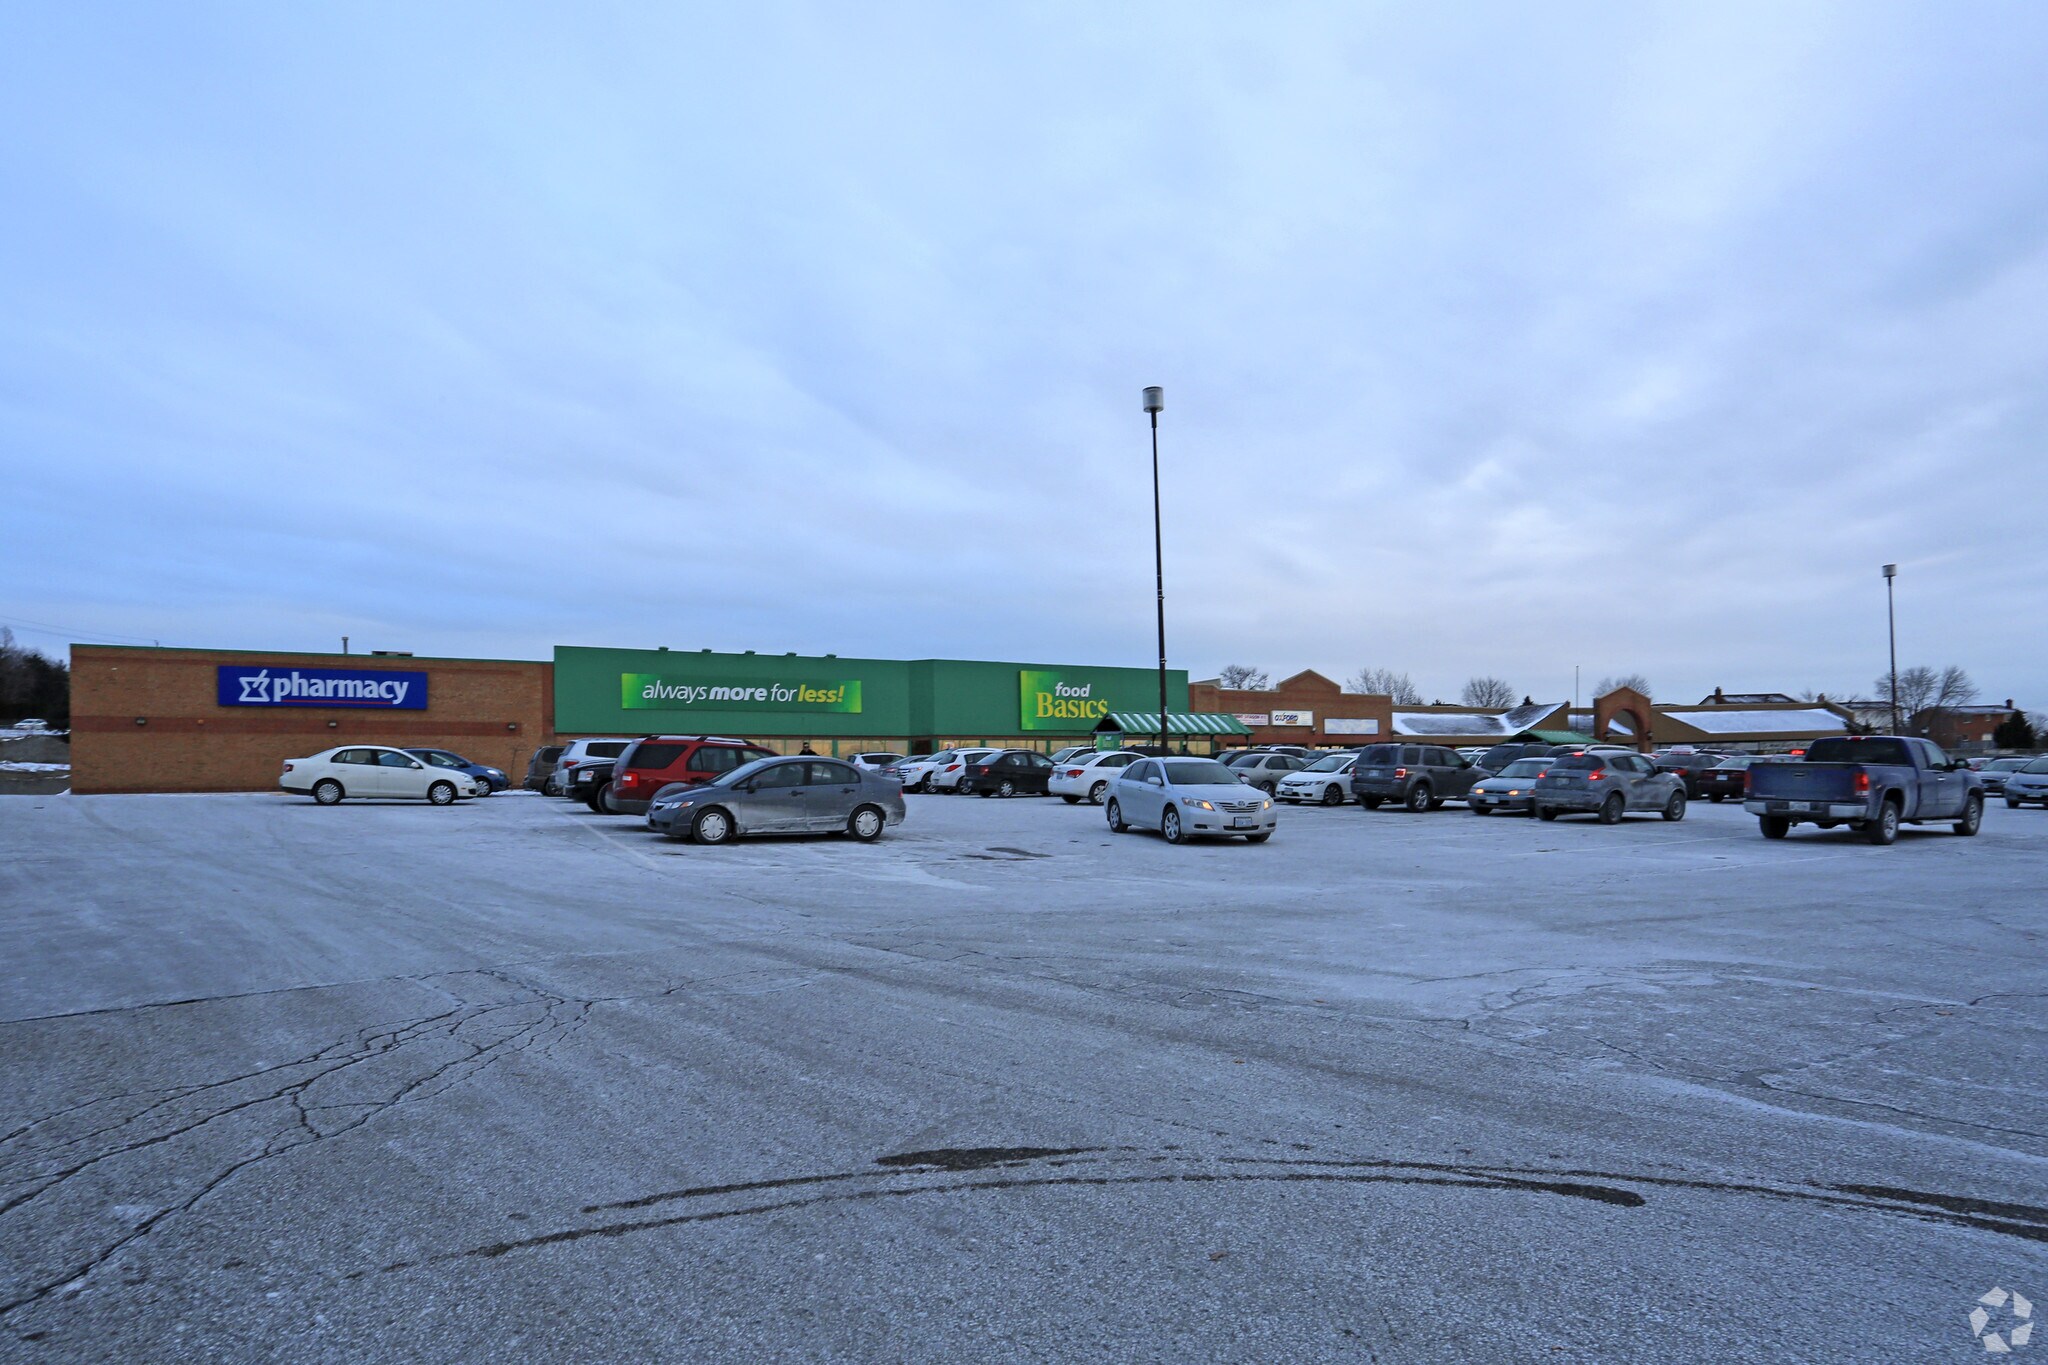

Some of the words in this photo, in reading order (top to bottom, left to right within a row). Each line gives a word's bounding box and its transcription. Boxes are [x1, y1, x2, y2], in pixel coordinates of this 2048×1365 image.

[273, 671, 409, 705] pharmacy
[642, 680, 707, 703] always
[709, 685, 767, 701] more
[770, 683, 797, 702] for
[798, 684, 845, 703] less!
[1055, 682, 1091, 697] food
